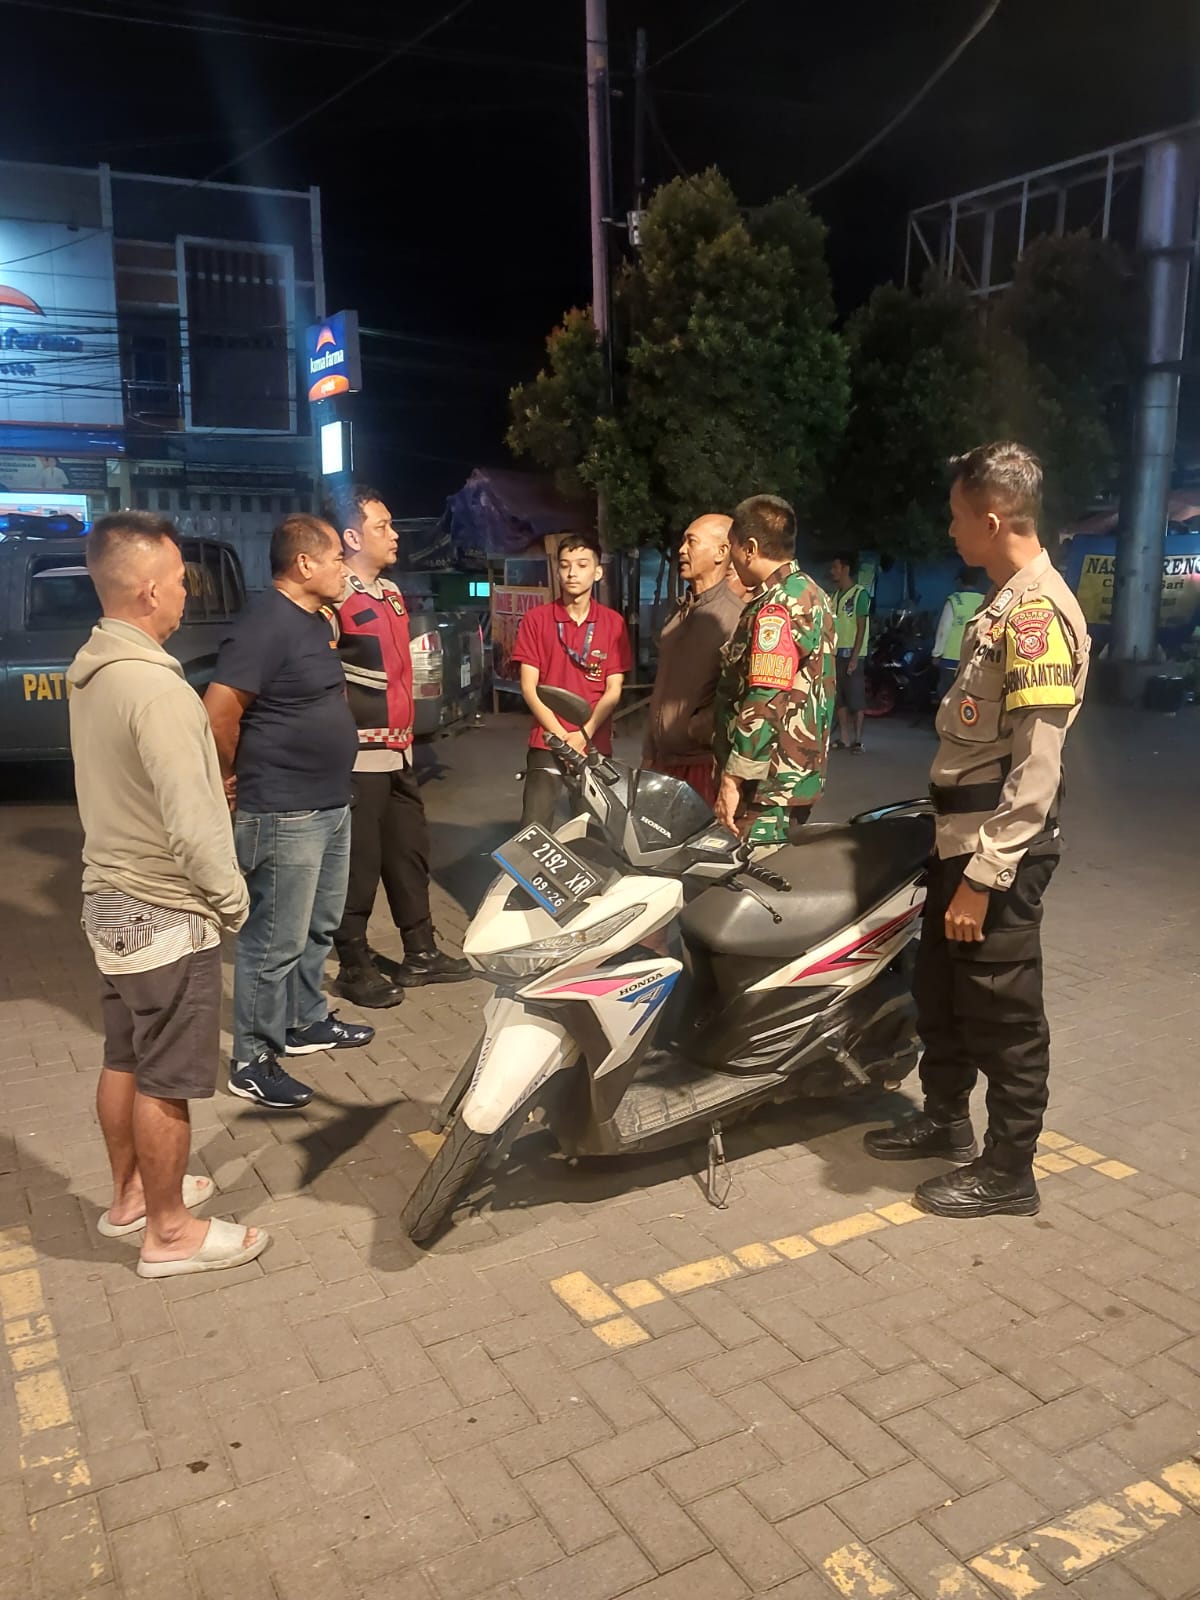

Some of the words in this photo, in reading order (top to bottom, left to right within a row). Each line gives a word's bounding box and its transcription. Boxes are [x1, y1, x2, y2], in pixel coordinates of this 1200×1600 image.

[640, 815, 672, 840] HONDA
[518, 829, 537, 844] F
[532, 842, 568, 875] 2192
[564, 872, 591, 895] XR
[619, 972, 664, 996] HONDA
